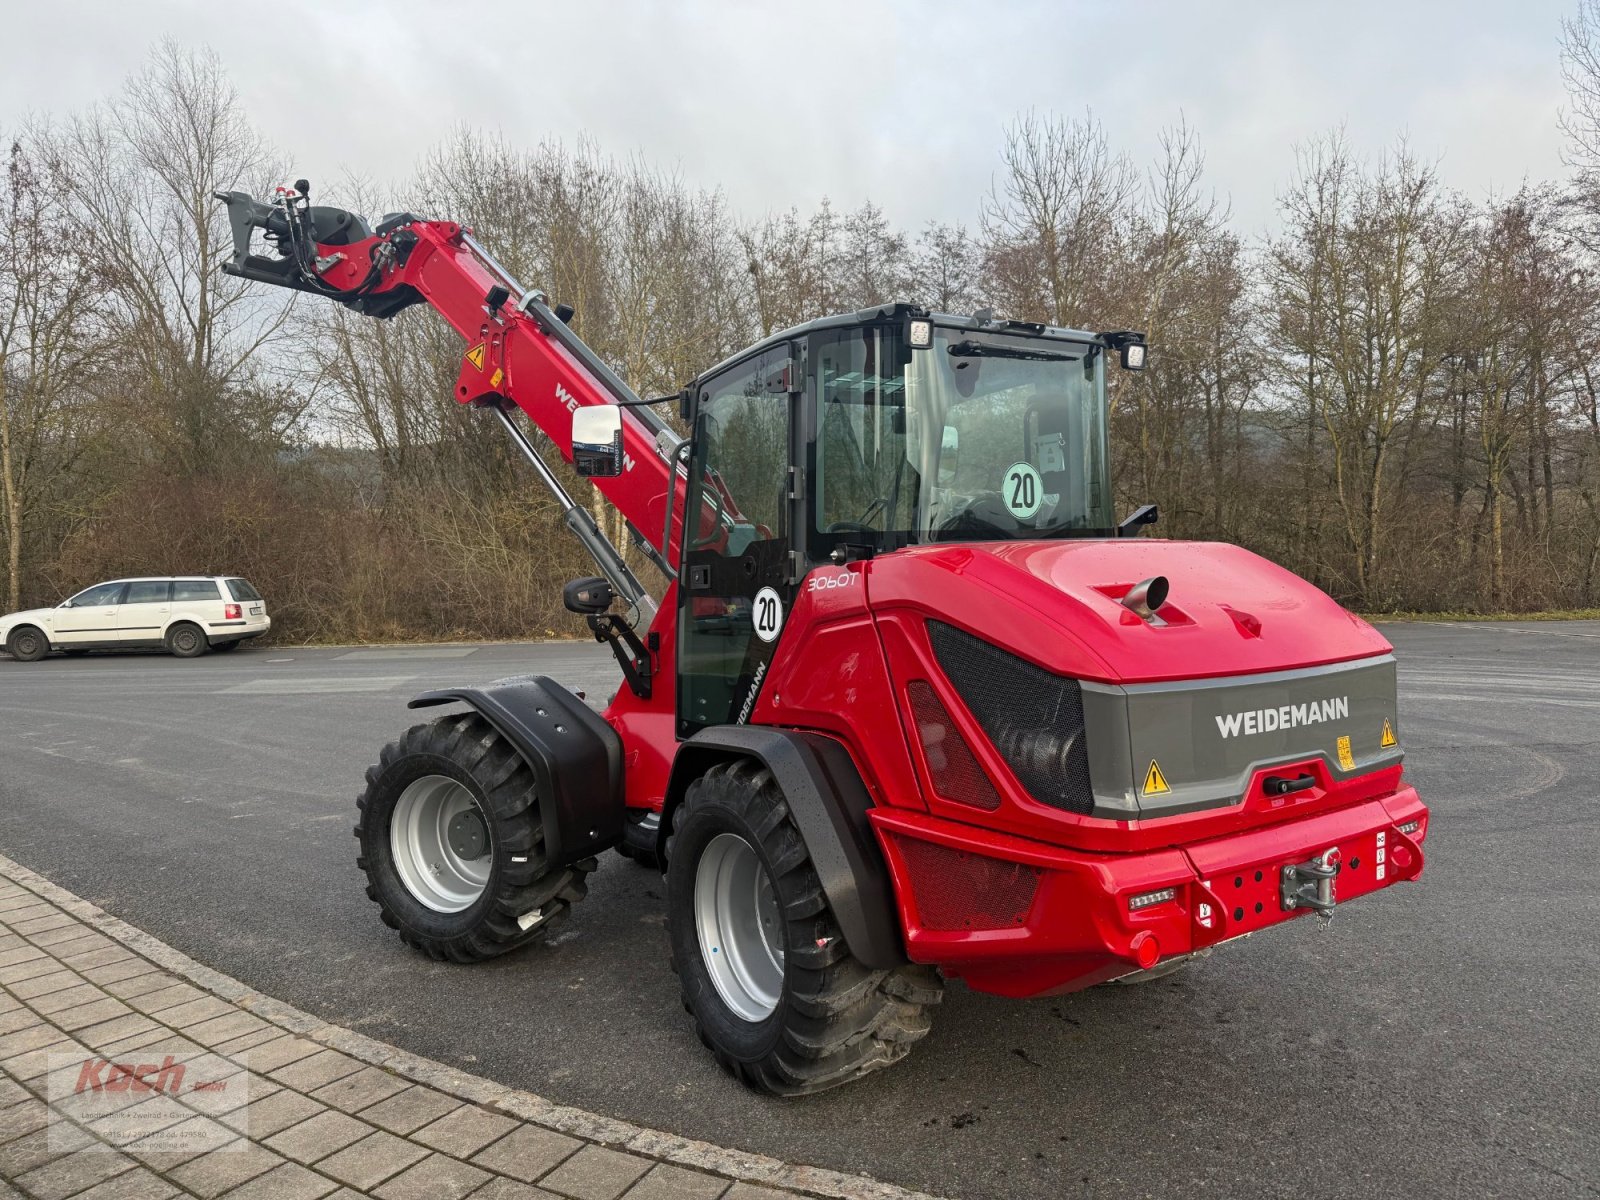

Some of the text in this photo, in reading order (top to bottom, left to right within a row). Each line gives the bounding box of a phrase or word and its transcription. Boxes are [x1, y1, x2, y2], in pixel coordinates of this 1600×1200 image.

[1010, 472, 1035, 509] 20
[808, 572, 859, 591] 3060T
[758, 597, 776, 632] 20
[736, 661, 766, 726] IDEMANN
[1215, 696, 1349, 739] WEIDEMANN
